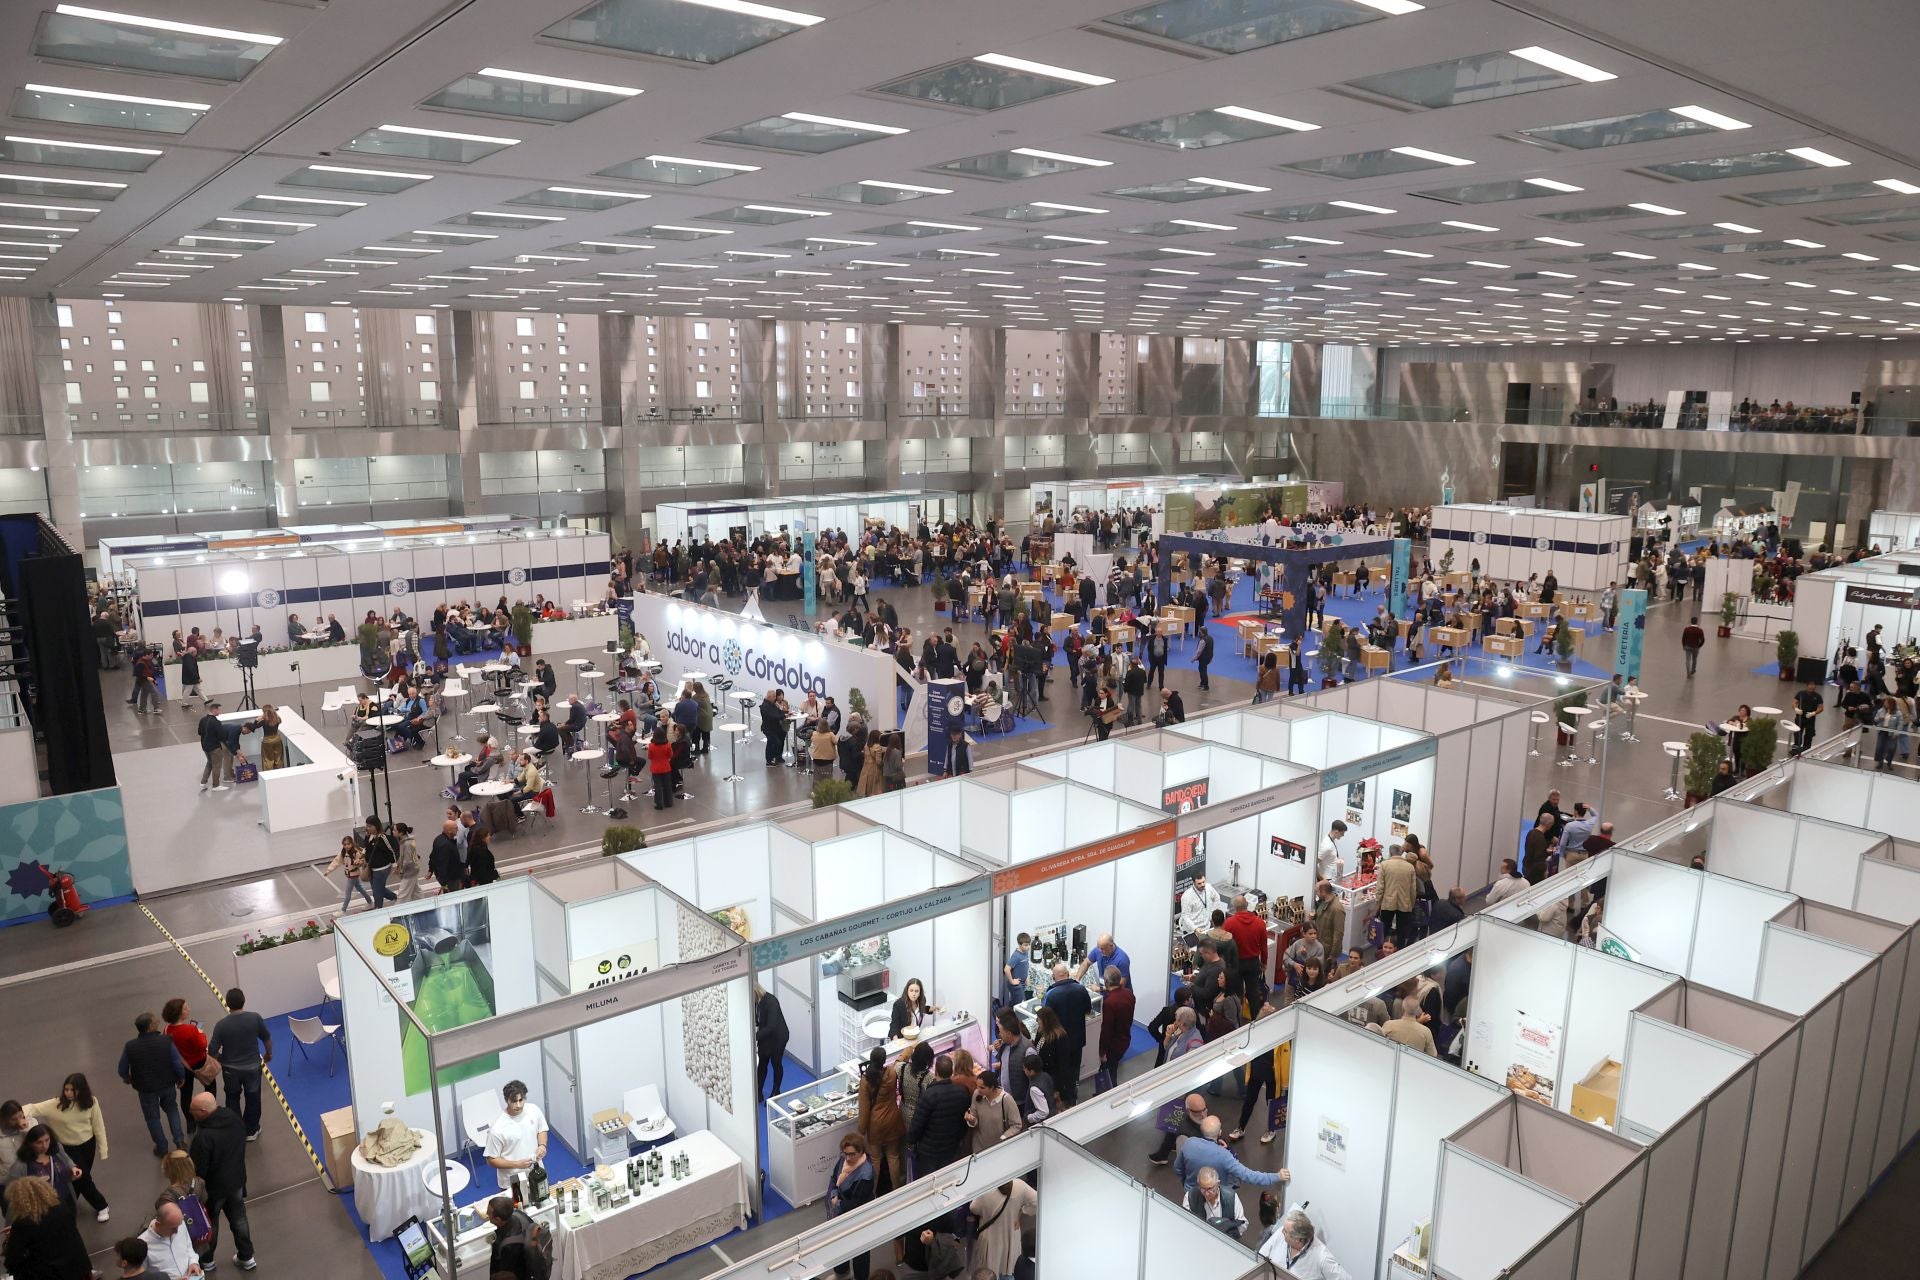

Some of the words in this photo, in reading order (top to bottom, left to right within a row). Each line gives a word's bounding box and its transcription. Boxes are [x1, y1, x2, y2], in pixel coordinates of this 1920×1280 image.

[709, 645, 720, 665] a
[800, 937, 813, 946] LOS
[815, 927, 847, 942] CABAÑAS
[848, 917, 879, 932] GOURMET
[886, 907, 913, 920] CORTIJO
[914, 904, 923, 912] LA
[924, 896, 952, 909] CALZADA
[586, 997, 618, 1011] MILUMA
